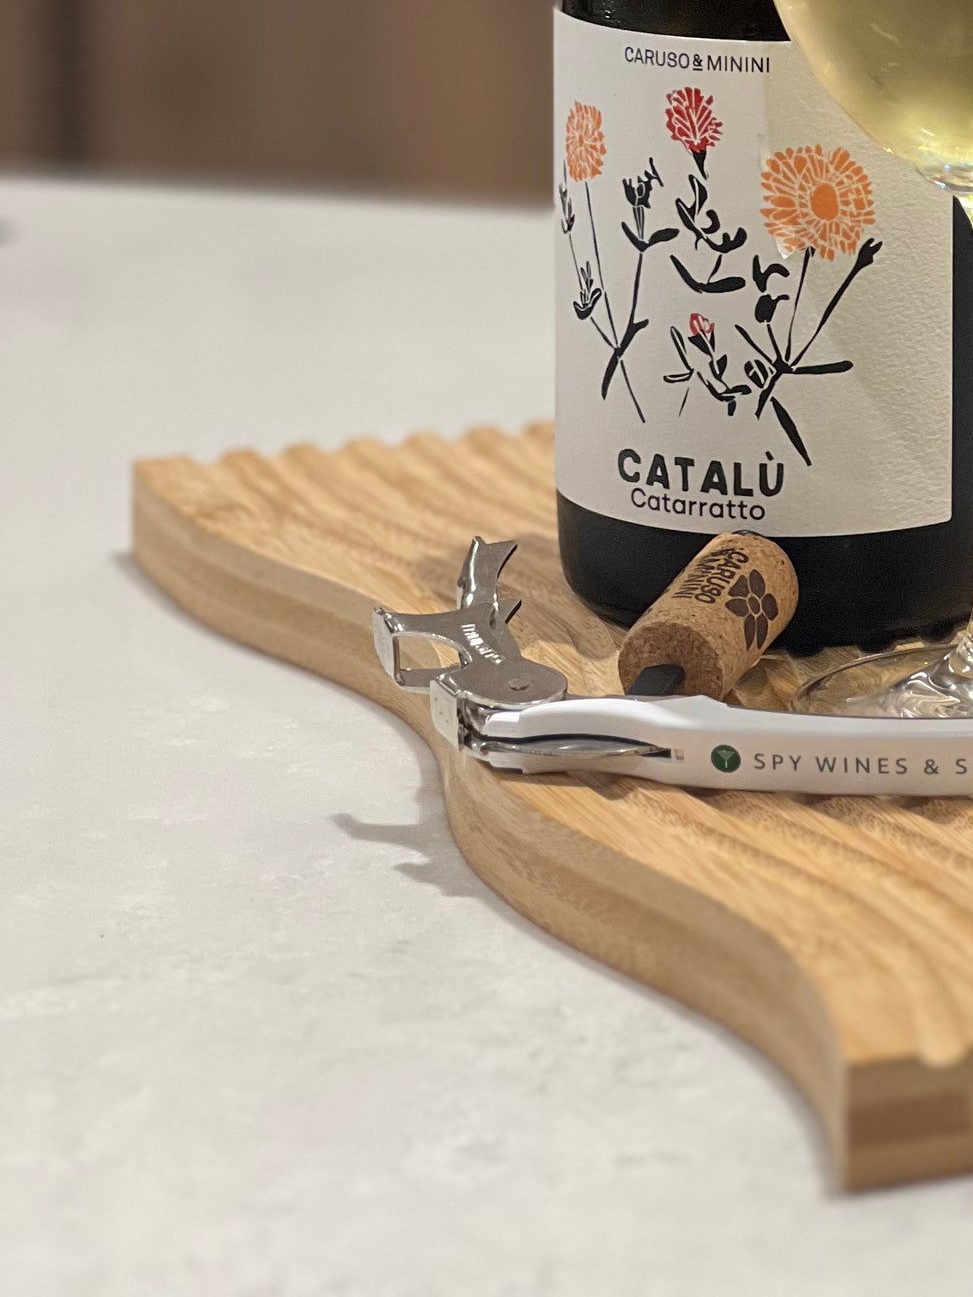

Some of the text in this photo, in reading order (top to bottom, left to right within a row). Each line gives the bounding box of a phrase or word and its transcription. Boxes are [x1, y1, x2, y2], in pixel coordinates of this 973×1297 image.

[618, 448, 784, 497] CATALÙ
[631, 487, 766, 520] Catarratto
[694, 551, 749, 604] CARUSO
[754, 753, 802, 772] SPY
[816, 755, 908, 775] WINES
[923, 758, 940, 775] &
